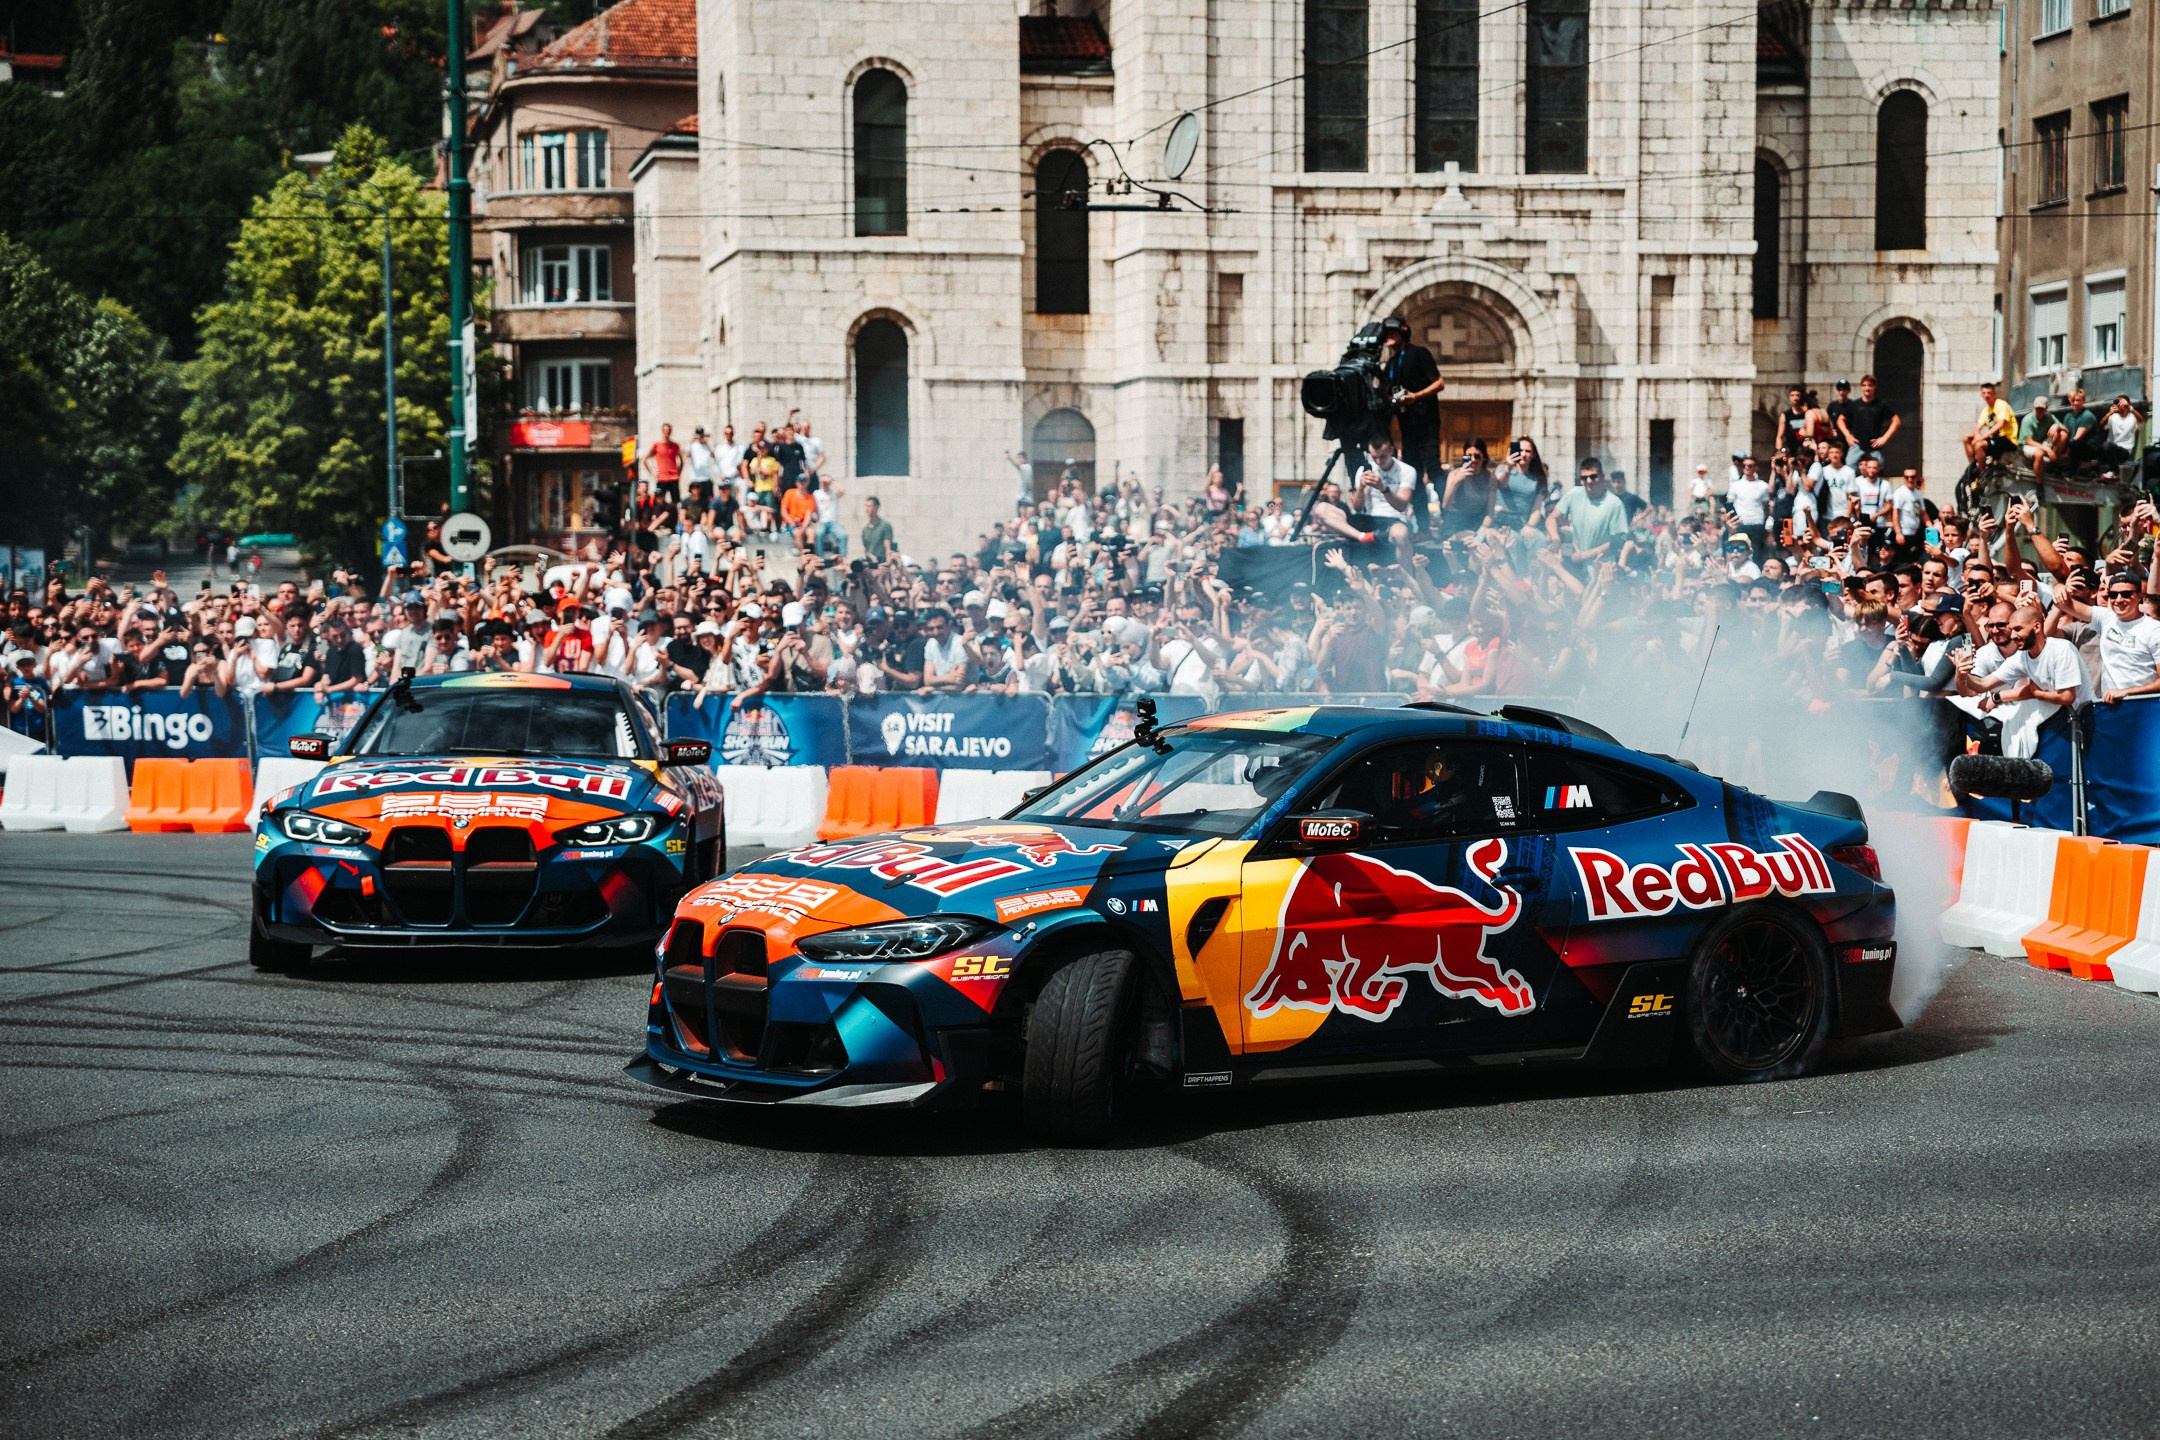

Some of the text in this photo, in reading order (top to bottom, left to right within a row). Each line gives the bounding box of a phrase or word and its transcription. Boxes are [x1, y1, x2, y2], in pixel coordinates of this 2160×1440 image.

[112, 705, 213, 749] Bingo
[907, 713, 955, 732] VISIT
[677, 747, 707, 757] MoTeC
[905, 735, 1011, 757] SARAJEVO
[312, 767, 632, 800] Red Bull
[379, 806, 546, 823] PERFORMANCE
[1307, 823, 1352, 836] MoTeC
[580, 850, 613, 859] tuning.pl
[822, 842, 1033, 897] Bull
[1568, 833, 1836, 921] Red Bull
[1003, 896, 1082, 916] PERFORMANCE
[1862, 947, 1892, 960] tuning.pl
[818, 969, 862, 980] tuning.pl
